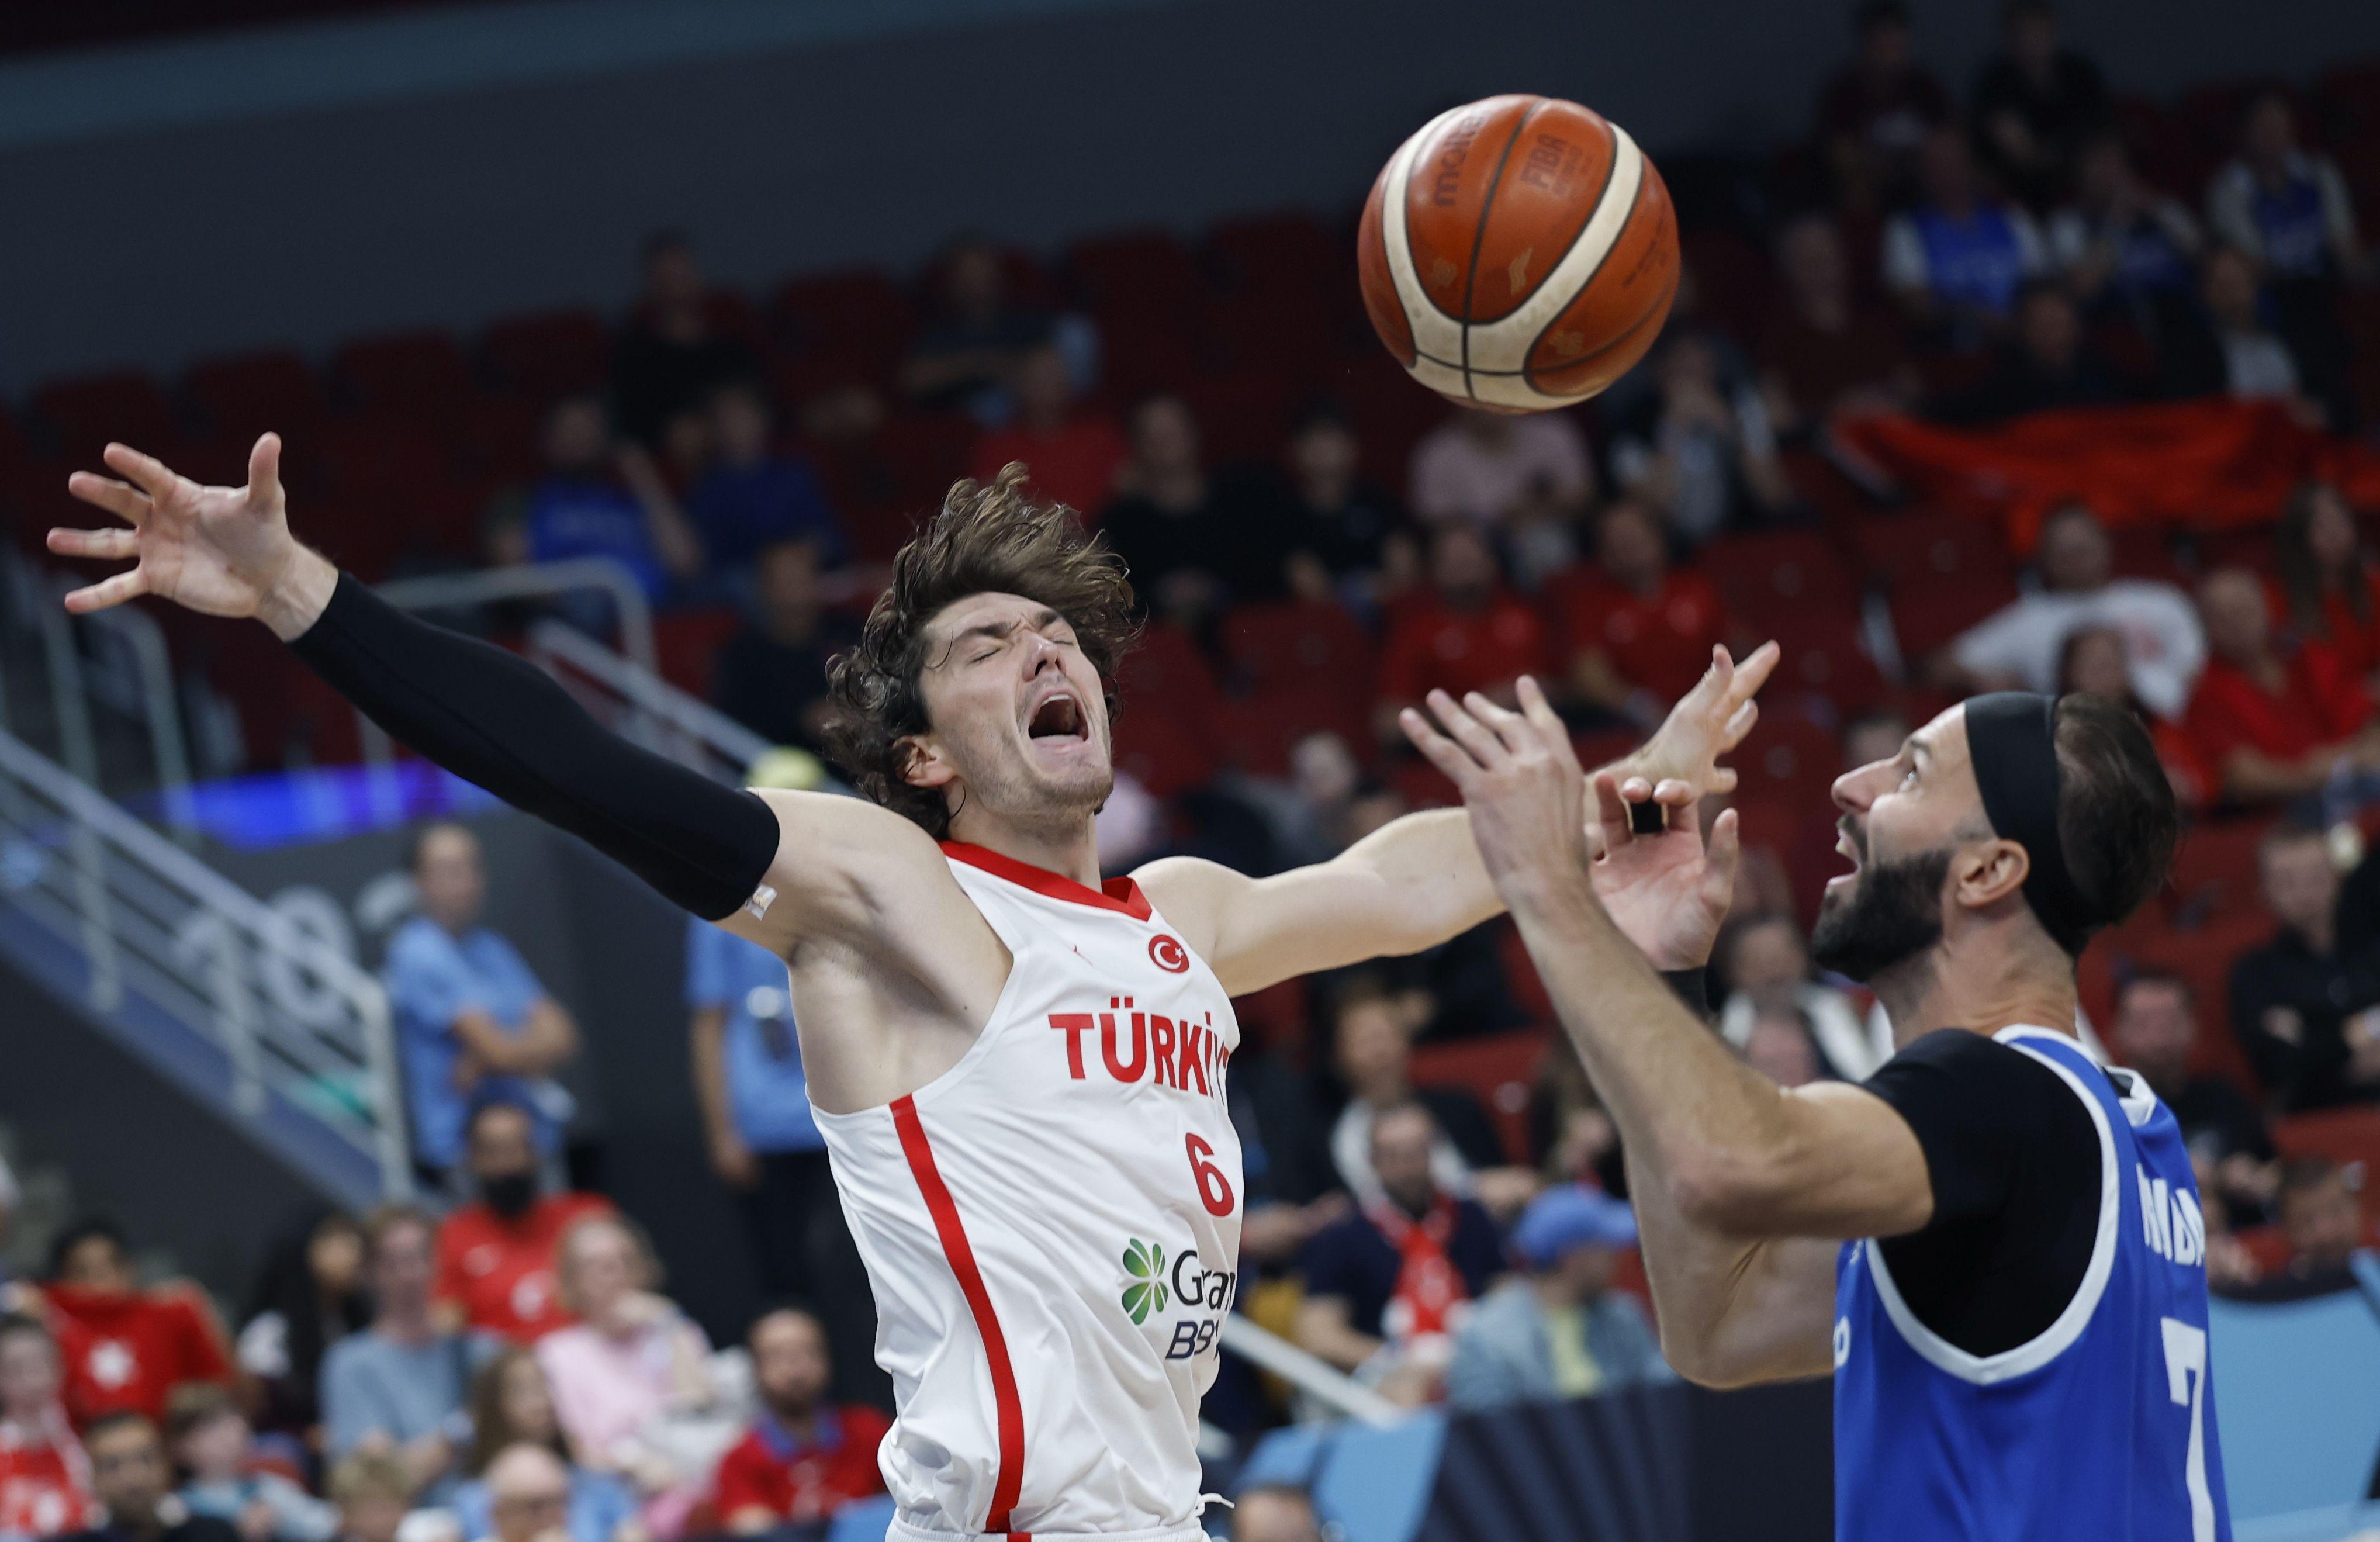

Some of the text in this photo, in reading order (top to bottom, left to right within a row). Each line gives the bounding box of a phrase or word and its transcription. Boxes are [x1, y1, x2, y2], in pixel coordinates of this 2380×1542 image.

[1521, 133, 1568, 189] FIBA
[1048, 996, 1230, 1105] TÜRKİY
[1185, 1132, 1234, 1216] 6
[1165, 1319, 1220, 1361] BB
[2160, 1317, 2216, 1541] 7
